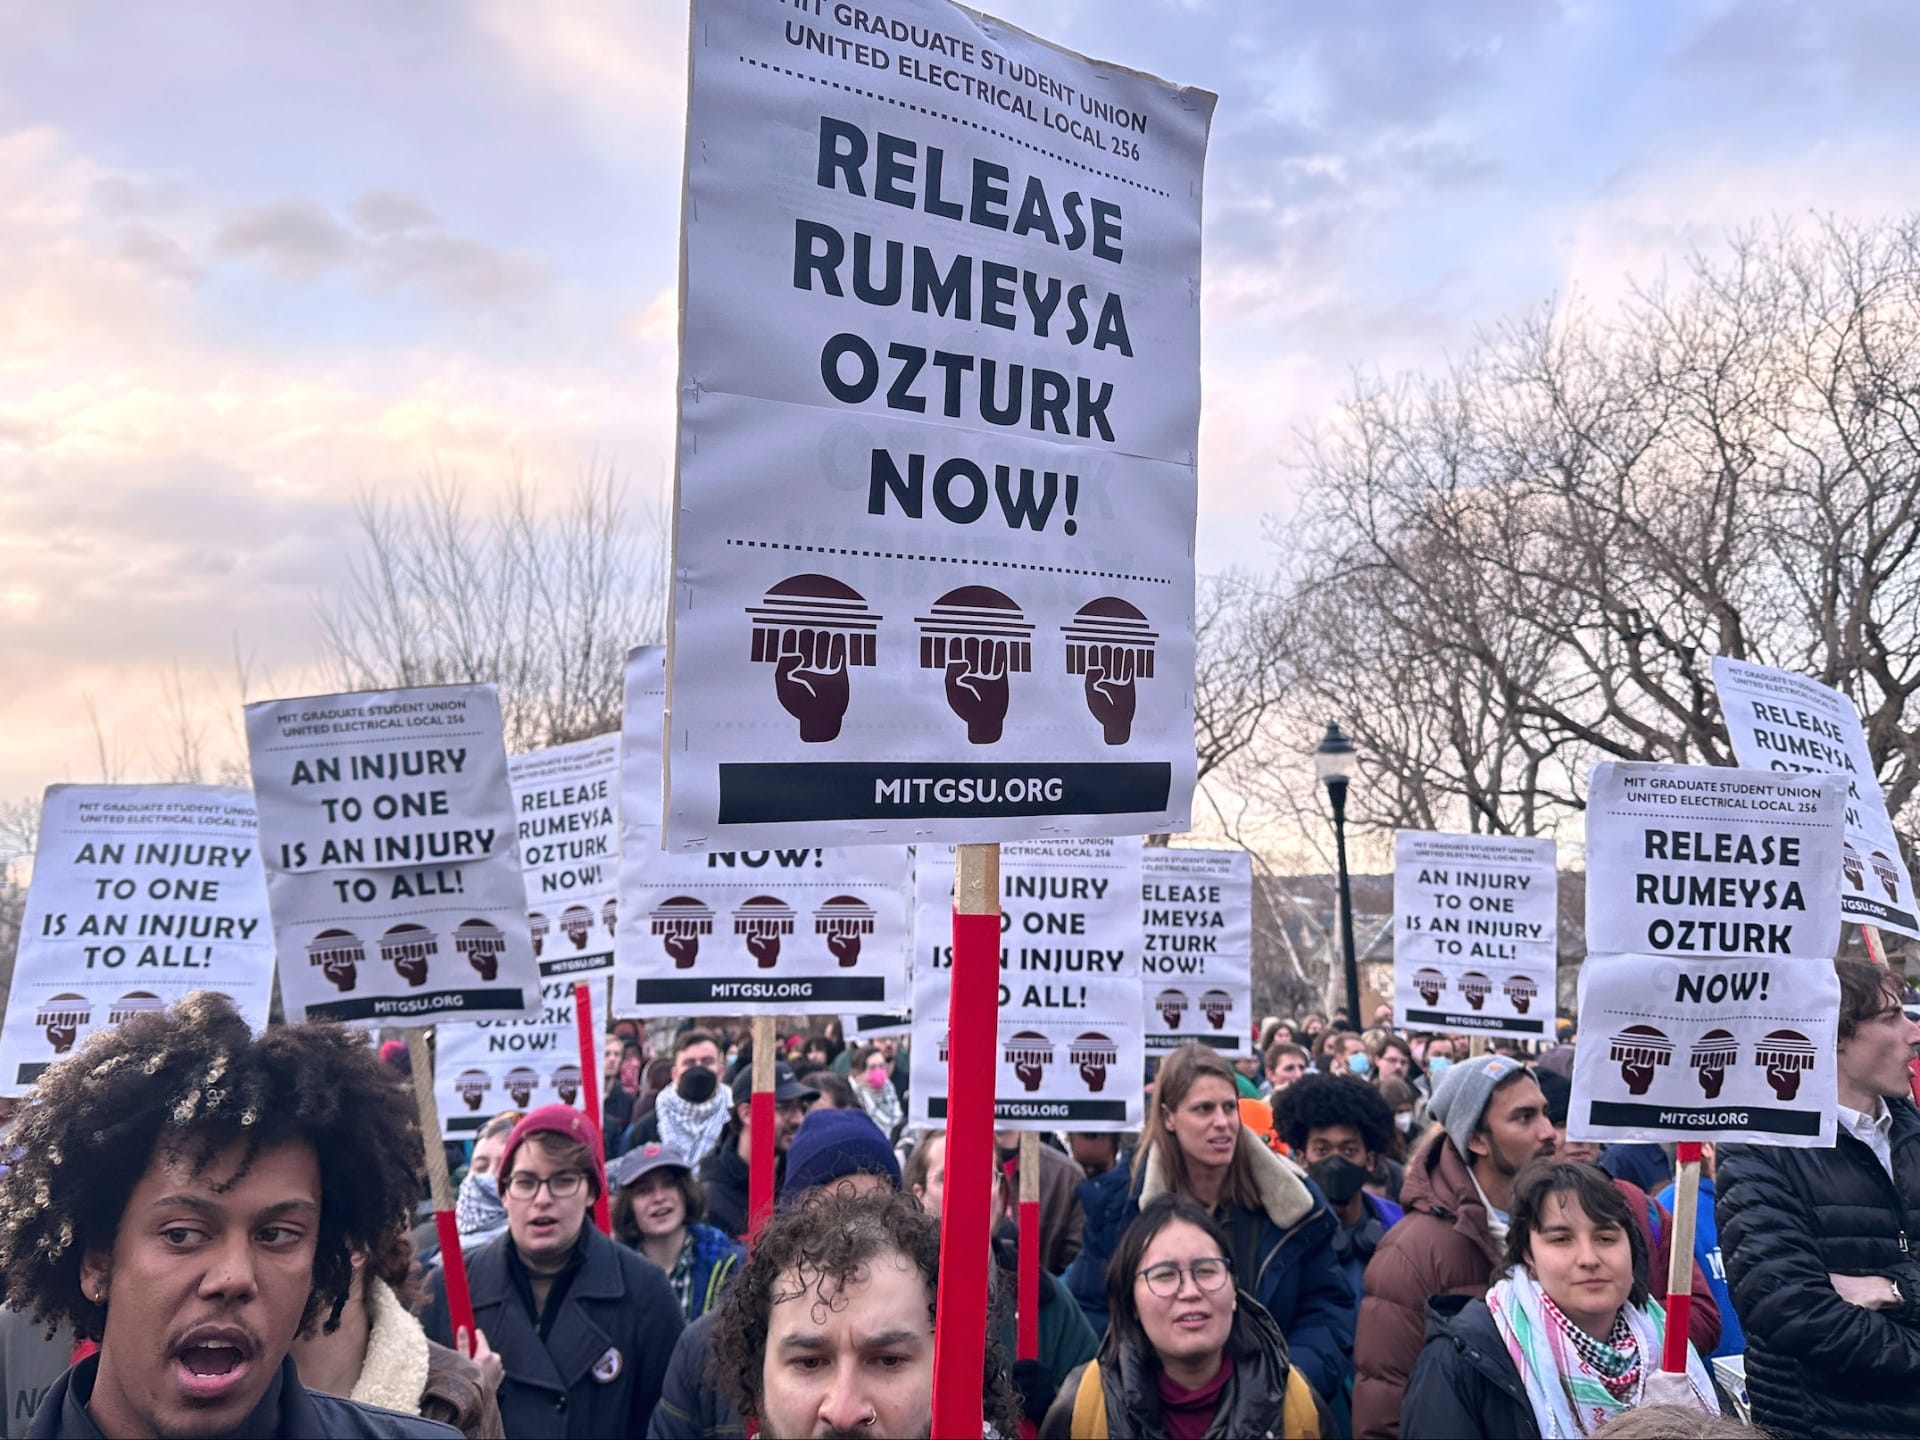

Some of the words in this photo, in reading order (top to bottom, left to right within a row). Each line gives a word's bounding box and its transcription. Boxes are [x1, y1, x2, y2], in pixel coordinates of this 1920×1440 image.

[833, 3, 974, 63] GRADUATE
[981, 49, 1075, 106] STUDENT
[1080, 93, 1147, 134] UNION
[785, 20, 890, 70] UNITED
[899, 55, 1038, 122] ELECTRICAL
[1043, 107, 1106, 150] LOCAL
[1111, 136, 1140, 161] 256
[817, 116, 1125, 265] RELEASE
[793, 218, 1133, 358] RUMEYSA
[821, 333, 1116, 442] OZTURK
[867, 449, 1079, 536] NOW!
[277, 713, 298, 724] MIT
[302, 707, 364, 722] GRADUATE
[368, 702, 424, 717] STUDENT
[427, 700, 467, 712] UNION
[1751, 701, 1844, 744] RELEASE
[283, 724, 330, 737] UNITED
[333, 719, 405, 733] ELECTRICAL
[407, 716, 443, 727] LOCAL
[446, 714, 465, 724] 256
[1753, 728, 1857, 774] RUMEYSA
[291, 757, 341, 785] AN
[351, 748, 467, 781] INJURY
[522, 780, 607, 812] RELEASE
[875, 778, 1063, 804] MITGSU.ORG
[1624, 777, 1646, 788] MIT
[1650, 778, 1717, 792] GRADUATE
[1720, 784, 1774, 796] STUDENT
[1777, 787, 1821, 799] UNION
[103, 803, 162, 812] GRADUATE
[165, 803, 220, 814] STUDENT
[321, 797, 362, 823] TO
[373, 790, 449, 819] ONE
[1627, 792, 1677, 804] UNITED
[1681, 795, 1748, 809] ELECTRICAL
[1751, 800, 1794, 812] LOCAL
[1798, 803, 1817, 813] 256
[80, 815, 125, 823] UNITED
[128, 815, 195, 824] ELECTRICAL
[199, 816, 236, 827] LOCAL
[519, 807, 613, 840] RUMEYSA
[74, 843, 125, 864] AN
[135, 843, 251, 868] INJURY
[281, 842, 307, 869] IS
[320, 838, 364, 865] AN
[375, 827, 496, 862] INJURY
[525, 835, 607, 865] OZTURK
[1057, 848, 1092, 857] LOCAL
[1644, 829, 1800, 866] RELEASE
[95, 878, 136, 900] TO
[147, 878, 219, 901] ONE
[333, 878, 376, 902] TO
[391, 870, 464, 900] ALL!
[542, 865, 603, 892] NOW!
[1005, 876, 1109, 901] INJURY
[1418, 869, 1448, 885] AN
[1456, 872, 1530, 890] INJURY
[1142, 885, 1221, 903] ELEASE
[1434, 894, 1461, 909] TO
[1469, 897, 1514, 913] ONE
[1636, 874, 1806, 911] RUMEYSA
[42, 913, 67, 936] IS
[78, 913, 128, 936] AN
[138, 914, 258, 939] INJURY
[1023, 911, 1085, 934] ONE
[1406, 915, 1421, 930] IS
[1429, 918, 1459, 933] AN
[1467, 920, 1542, 938] INJURY
[1145, 934, 1217, 953] ZTURK
[1648, 919, 1792, 954] OZTURK
[83, 946, 126, 968] TO
[136, 945, 213, 968] ALL!
[933, 946, 953, 968] IS
[1021, 948, 1124, 973] INJURY
[1435, 939, 1462, 955] TO
[1470, 943, 1516, 960] ALL!
[1143, 956, 1204, 974] NOW!
[711, 983, 812, 997] MITGSU.ORG
[1022, 984, 1086, 1008] ALL!
[1675, 972, 1769, 1003] NOW!
[374, 994, 464, 1013] MITGSU.ORG
[1445, 1016, 1503, 1028] MITGSU.ORG
[489, 1032, 557, 1052] NOW!
[995, 1104, 1069, 1116] ITGSU.ORG
[1659, 1112, 1749, 1126] MITGSU.ORG
